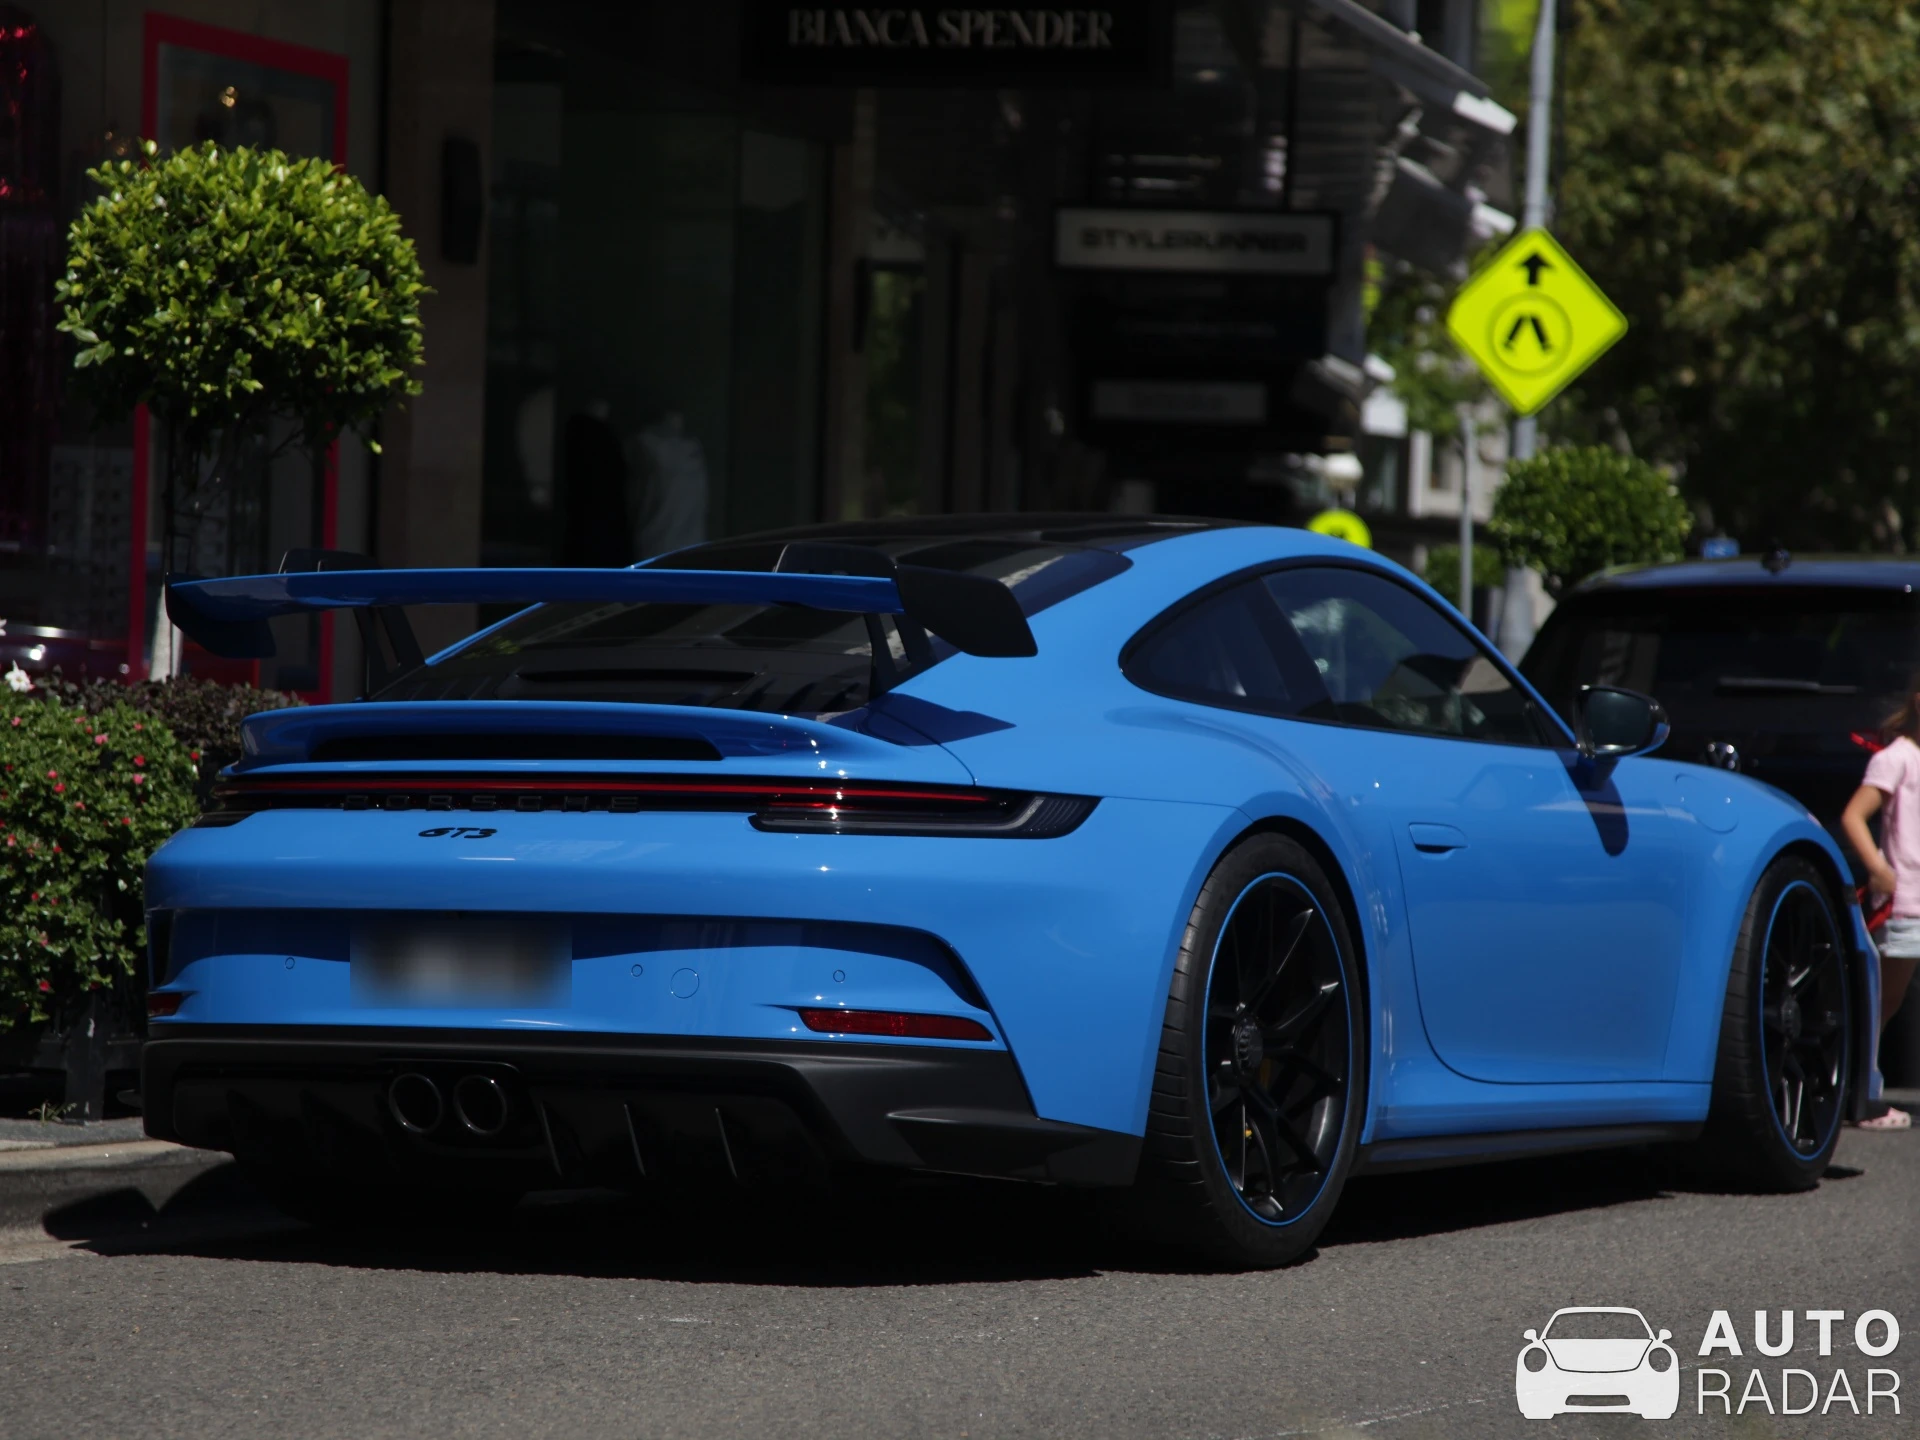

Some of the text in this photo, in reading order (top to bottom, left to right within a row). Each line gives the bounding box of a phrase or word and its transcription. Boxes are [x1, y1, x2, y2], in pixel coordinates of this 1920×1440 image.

[788, 8, 1113, 48] BIANCA SPENDER
[1080, 227, 1308, 253] STYLERUNNER
[343, 794, 641, 812] PORSCHE
[418, 826, 498, 839] GT3
